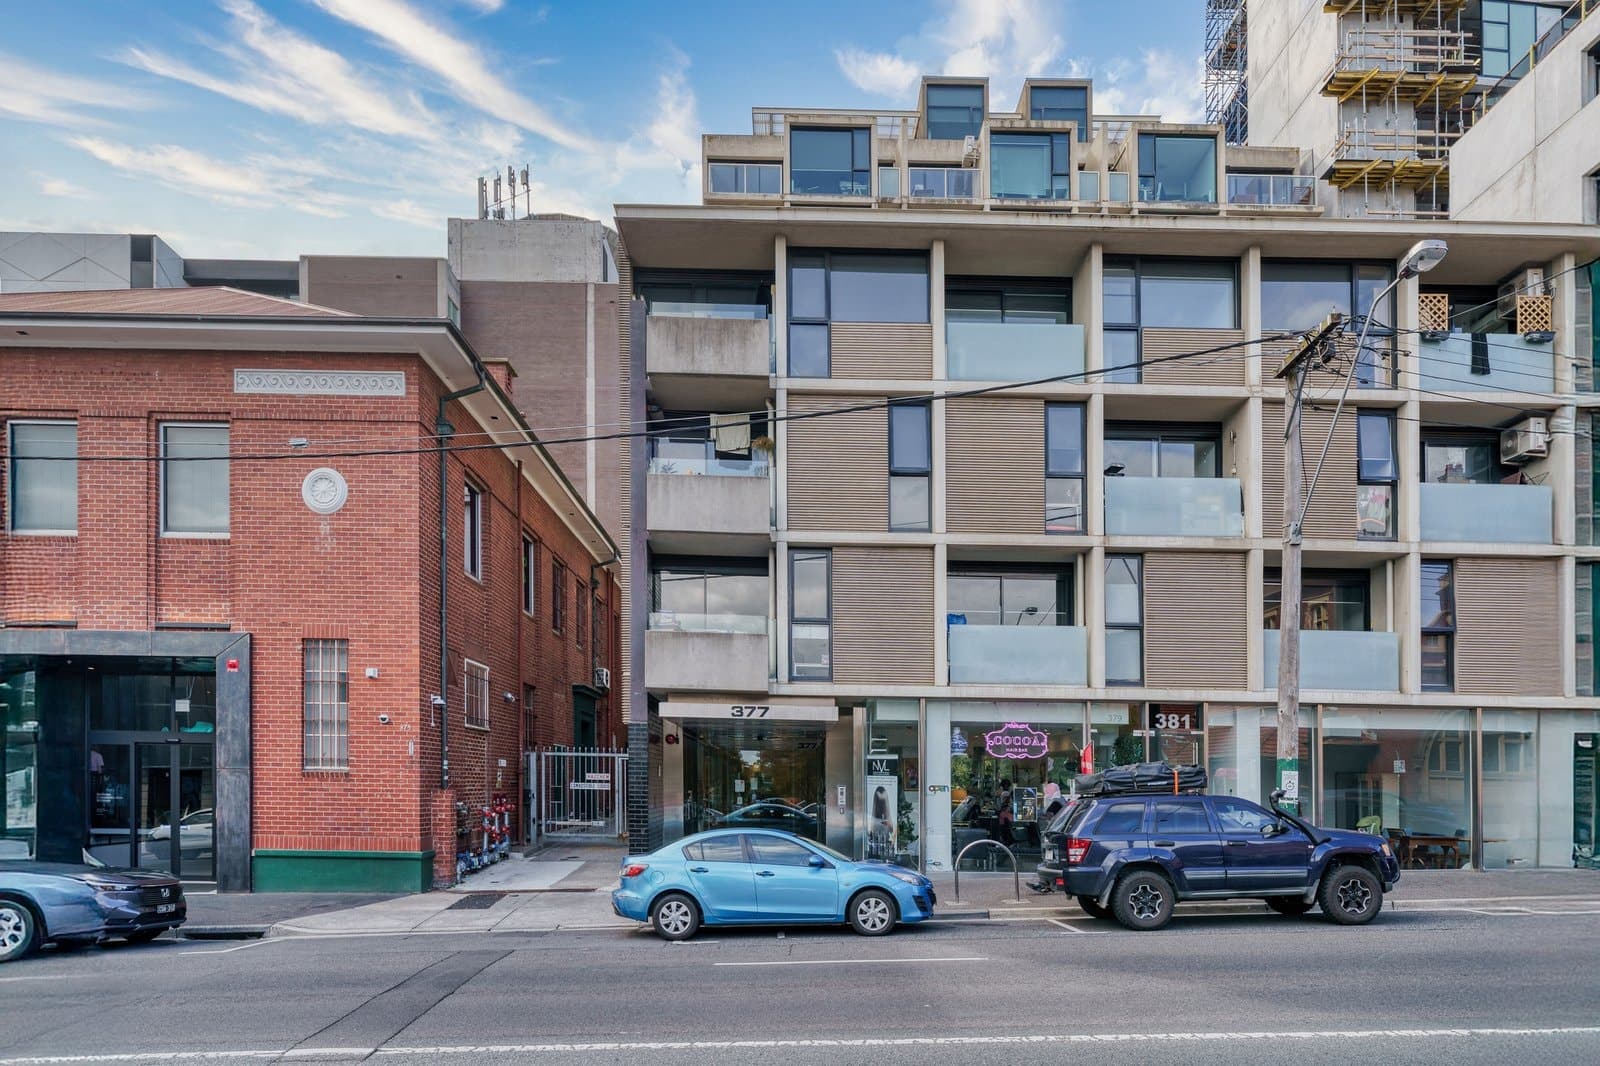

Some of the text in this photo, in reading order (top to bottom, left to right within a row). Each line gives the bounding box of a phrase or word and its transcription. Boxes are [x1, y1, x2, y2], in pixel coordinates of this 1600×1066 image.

[730, 705, 770, 718] 377
[1107, 713, 1123, 722] 379
[1154, 713, 1191, 730] 381
[993, 735, 1041, 746] COCOA
[928, 784, 950, 795] open
